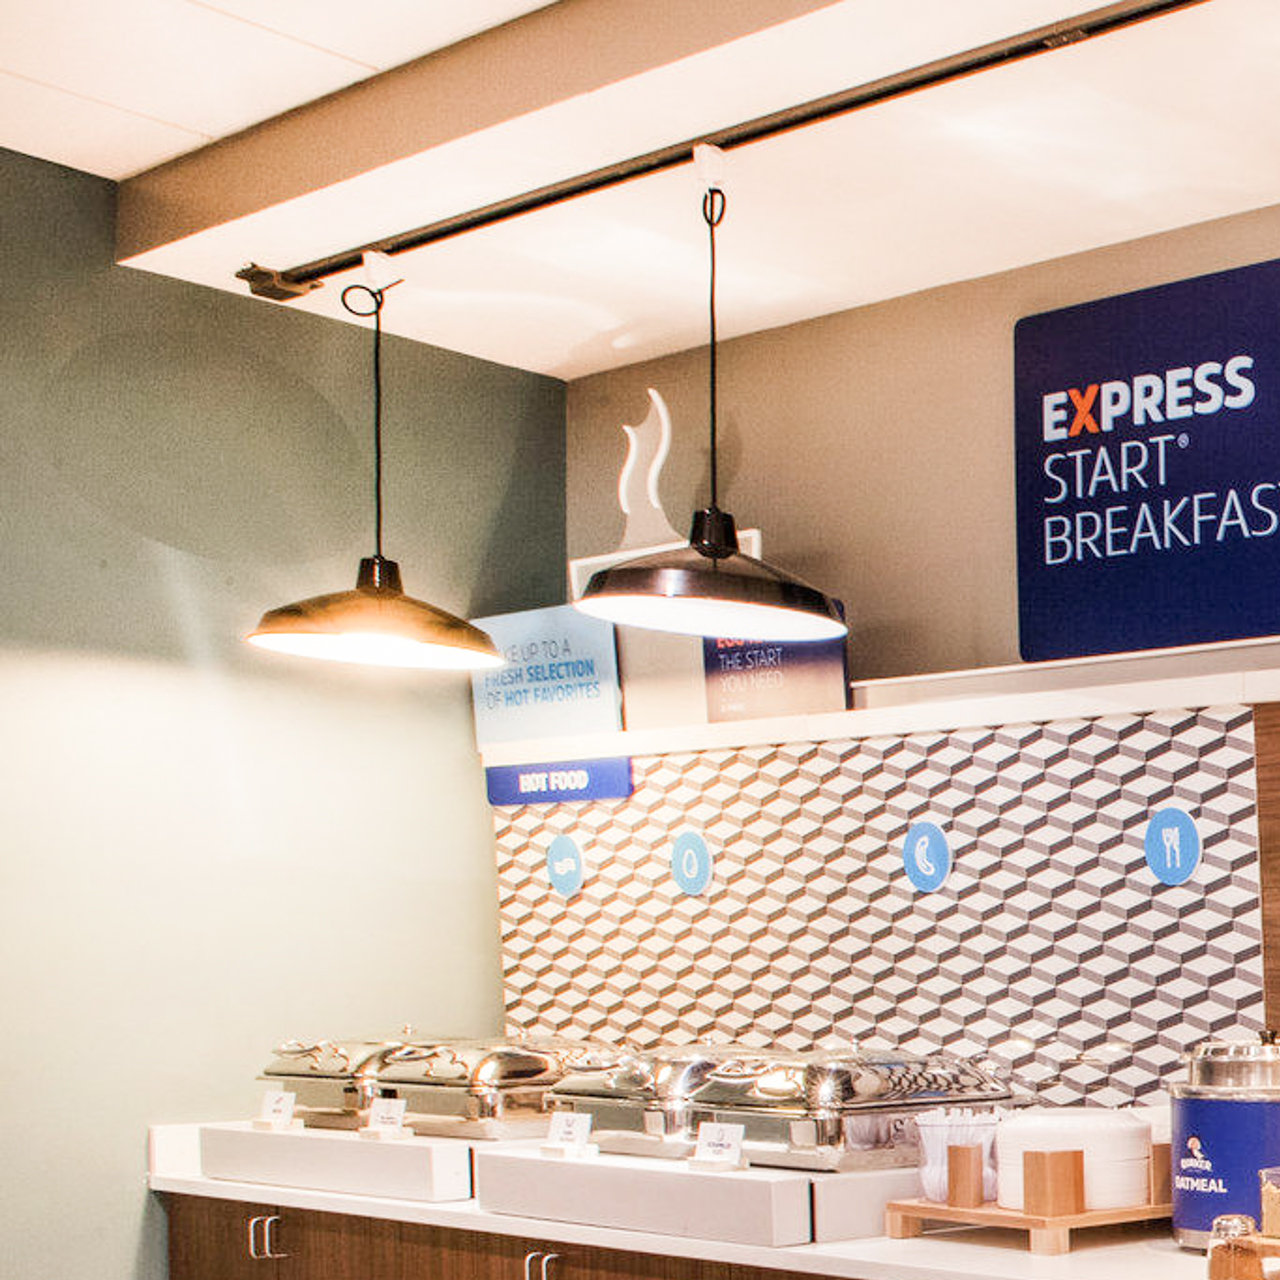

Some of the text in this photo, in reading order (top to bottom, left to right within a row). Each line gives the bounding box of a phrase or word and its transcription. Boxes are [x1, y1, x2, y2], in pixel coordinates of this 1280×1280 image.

[1042, 355, 1257, 442] EXPRESS
[526, 658, 595, 682] SELECTION
[719, 645, 783, 671] THE START
[503, 688, 529, 706] HOT
[518, 769, 590, 794] HOT FOOD
